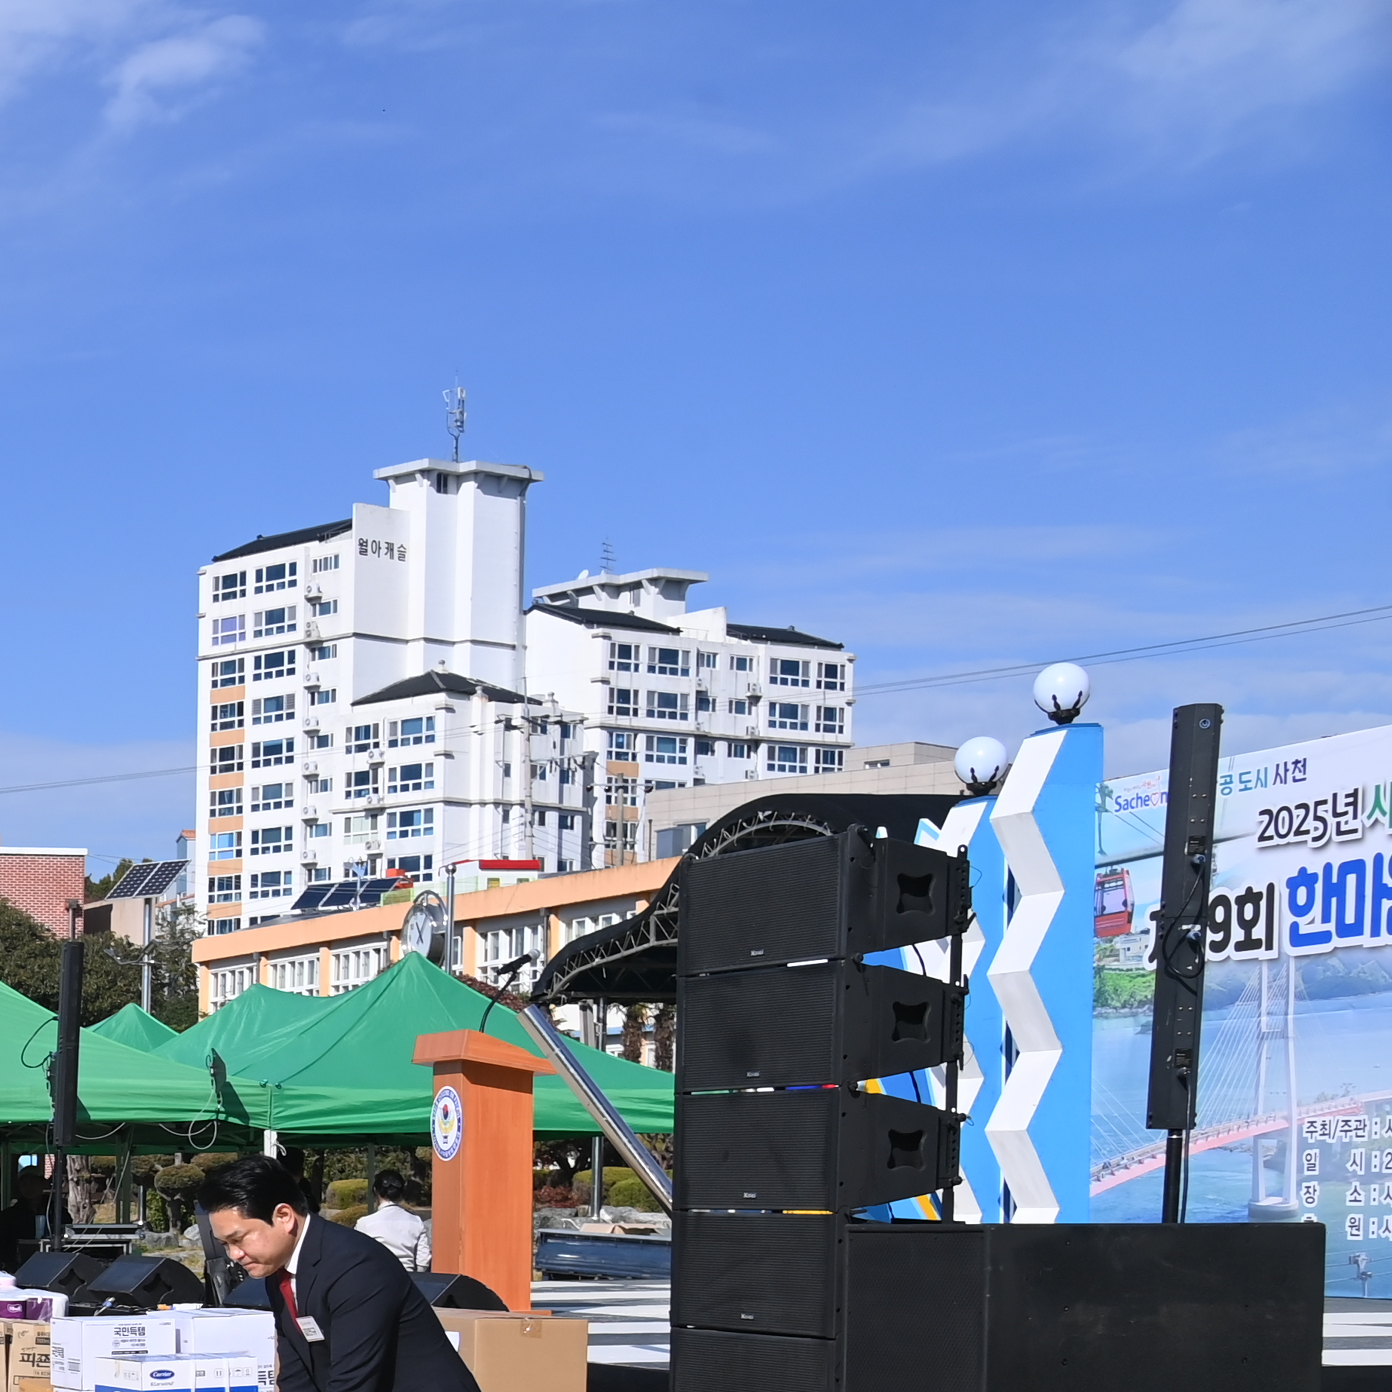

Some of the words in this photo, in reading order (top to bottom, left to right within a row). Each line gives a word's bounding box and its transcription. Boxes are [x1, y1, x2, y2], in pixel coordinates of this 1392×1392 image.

[358, 538, 407, 562] 월아캐슬
[1272, 757, 1308, 786] 사천
[1257, 787, 1360, 842] 2025년
[1286, 852, 1392, 948] 한마
[1304, 1118, 1367, 1140] 주최/주관
